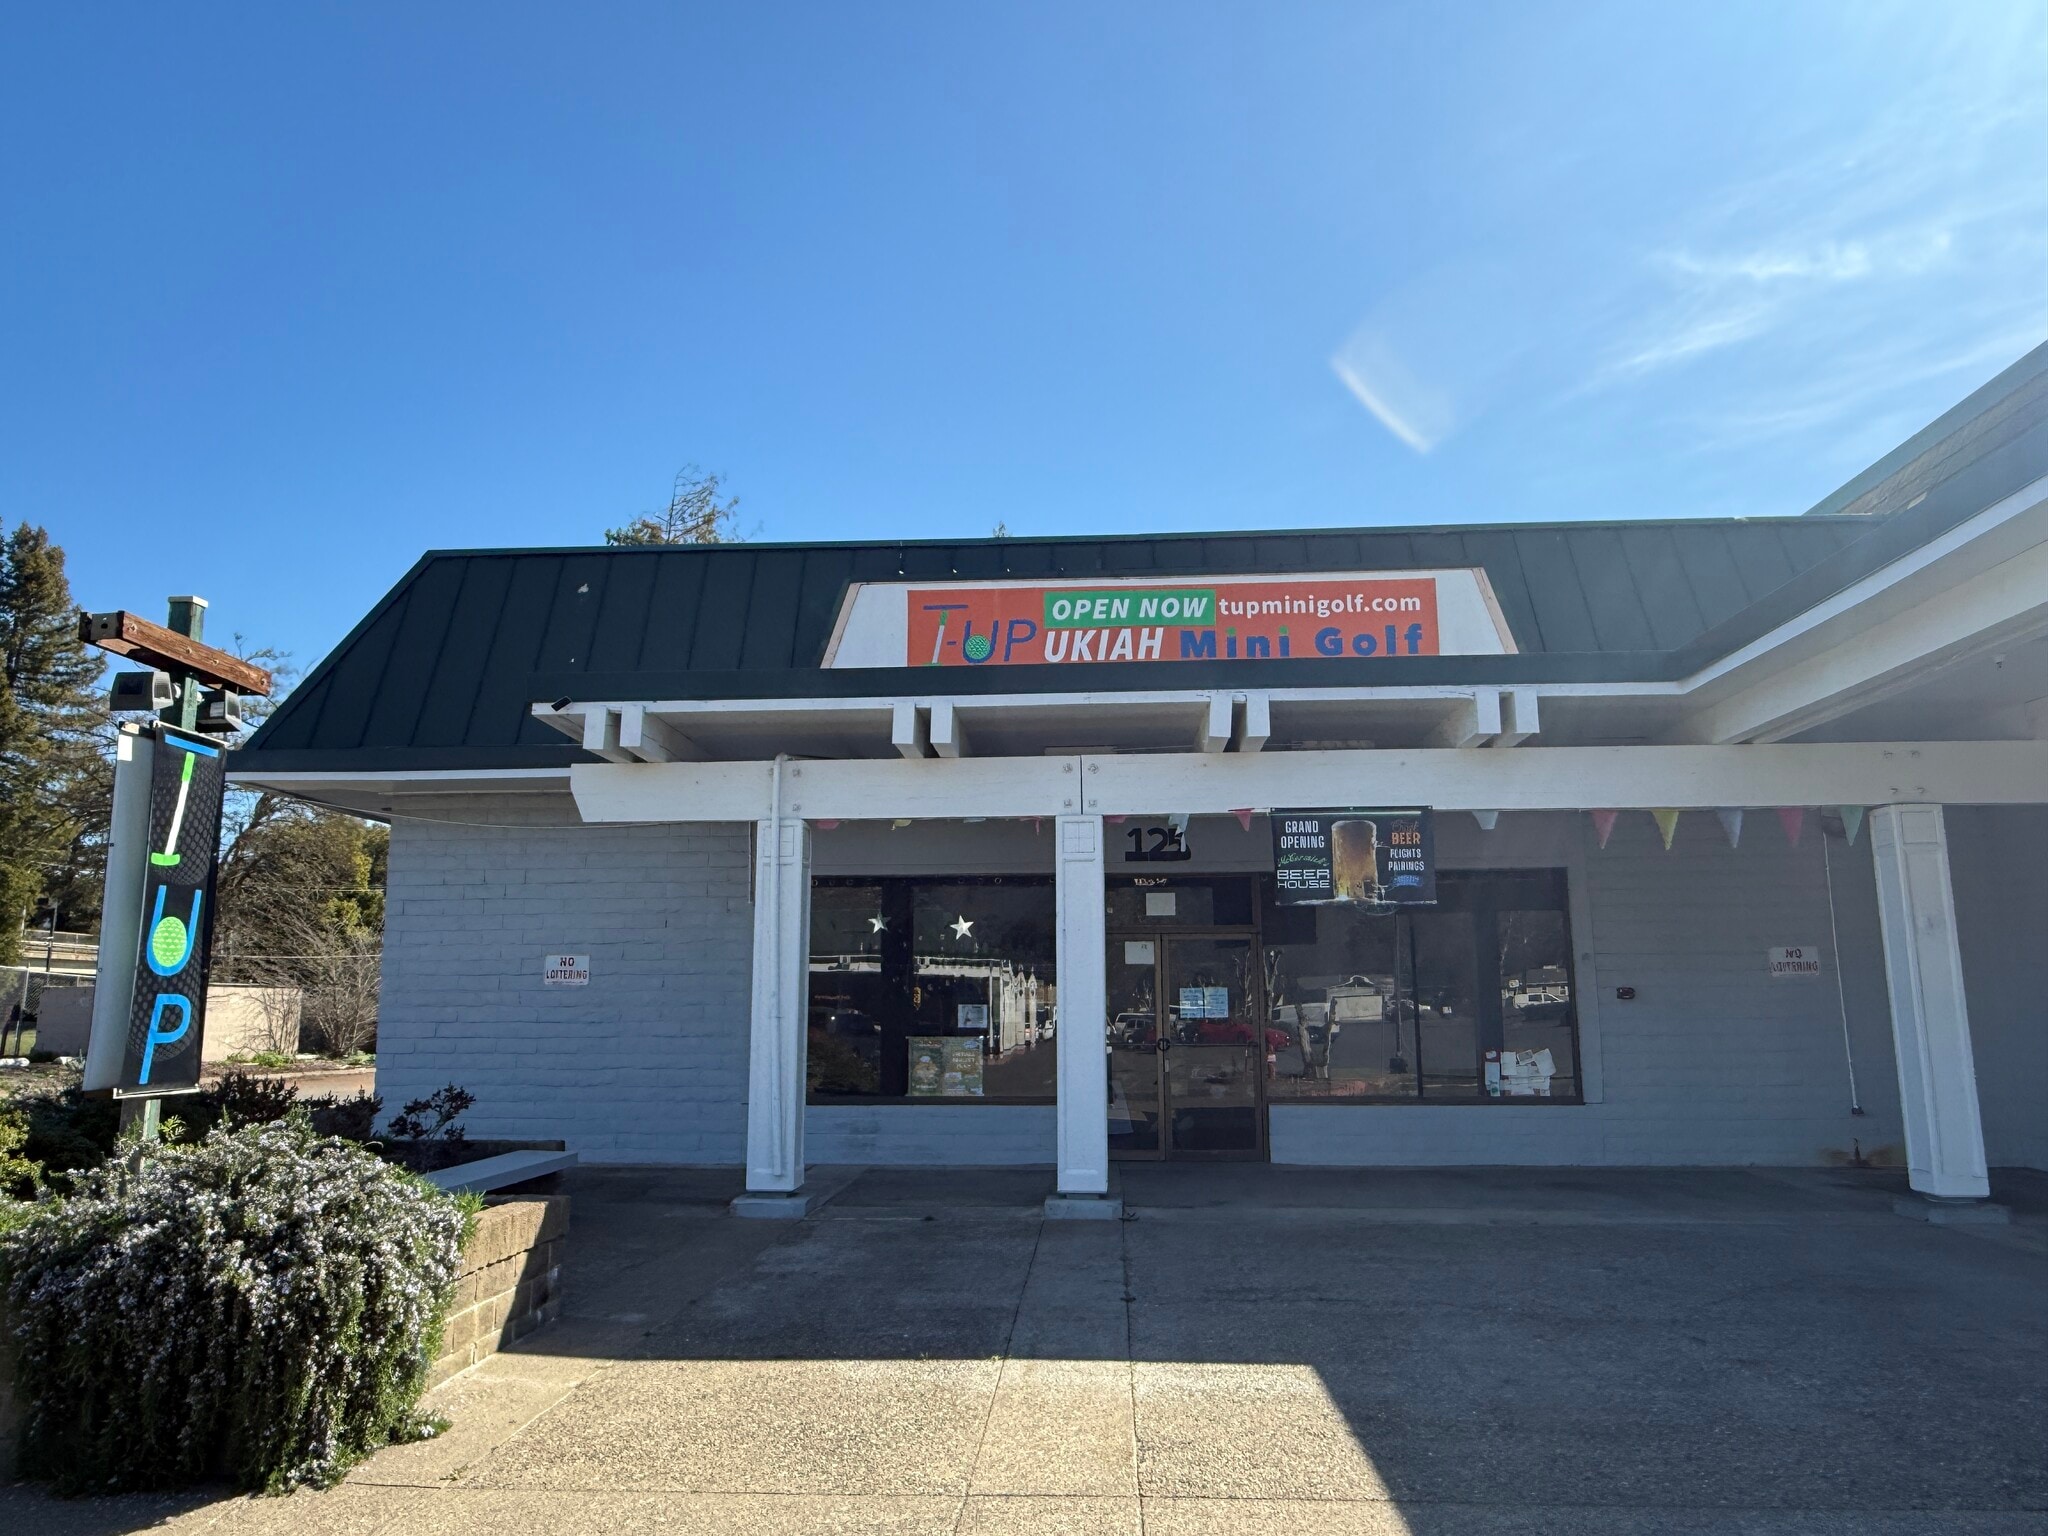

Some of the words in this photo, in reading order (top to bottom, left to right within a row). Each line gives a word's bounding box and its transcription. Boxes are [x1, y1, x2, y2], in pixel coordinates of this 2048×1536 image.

[1051, 598, 1129, 621] OPEN
[1139, 597, 1208, 619] NOW
[1219, 593, 1421, 618] tupminigolf.com
[1044, 627, 1165, 663] UKIAH
[1180, 625, 1290, 658] Mini
[1314, 623, 1423, 657] Golf
[1285, 820, 1319, 833] GRAND
[1280, 835, 1325, 848] OPENING
[1391, 832, 1421, 845] BEER
[1390, 848, 1422, 858] FLIGHTS
[1388, 861, 1425, 871] PAIRINGS
[1277, 869, 1330, 880] BEER
[1277, 880, 1330, 889] HOUSE
[1785, 948, 1803, 959] NO
[560, 957, 575, 967] NO
[546, 970, 588, 980] LOITERING
